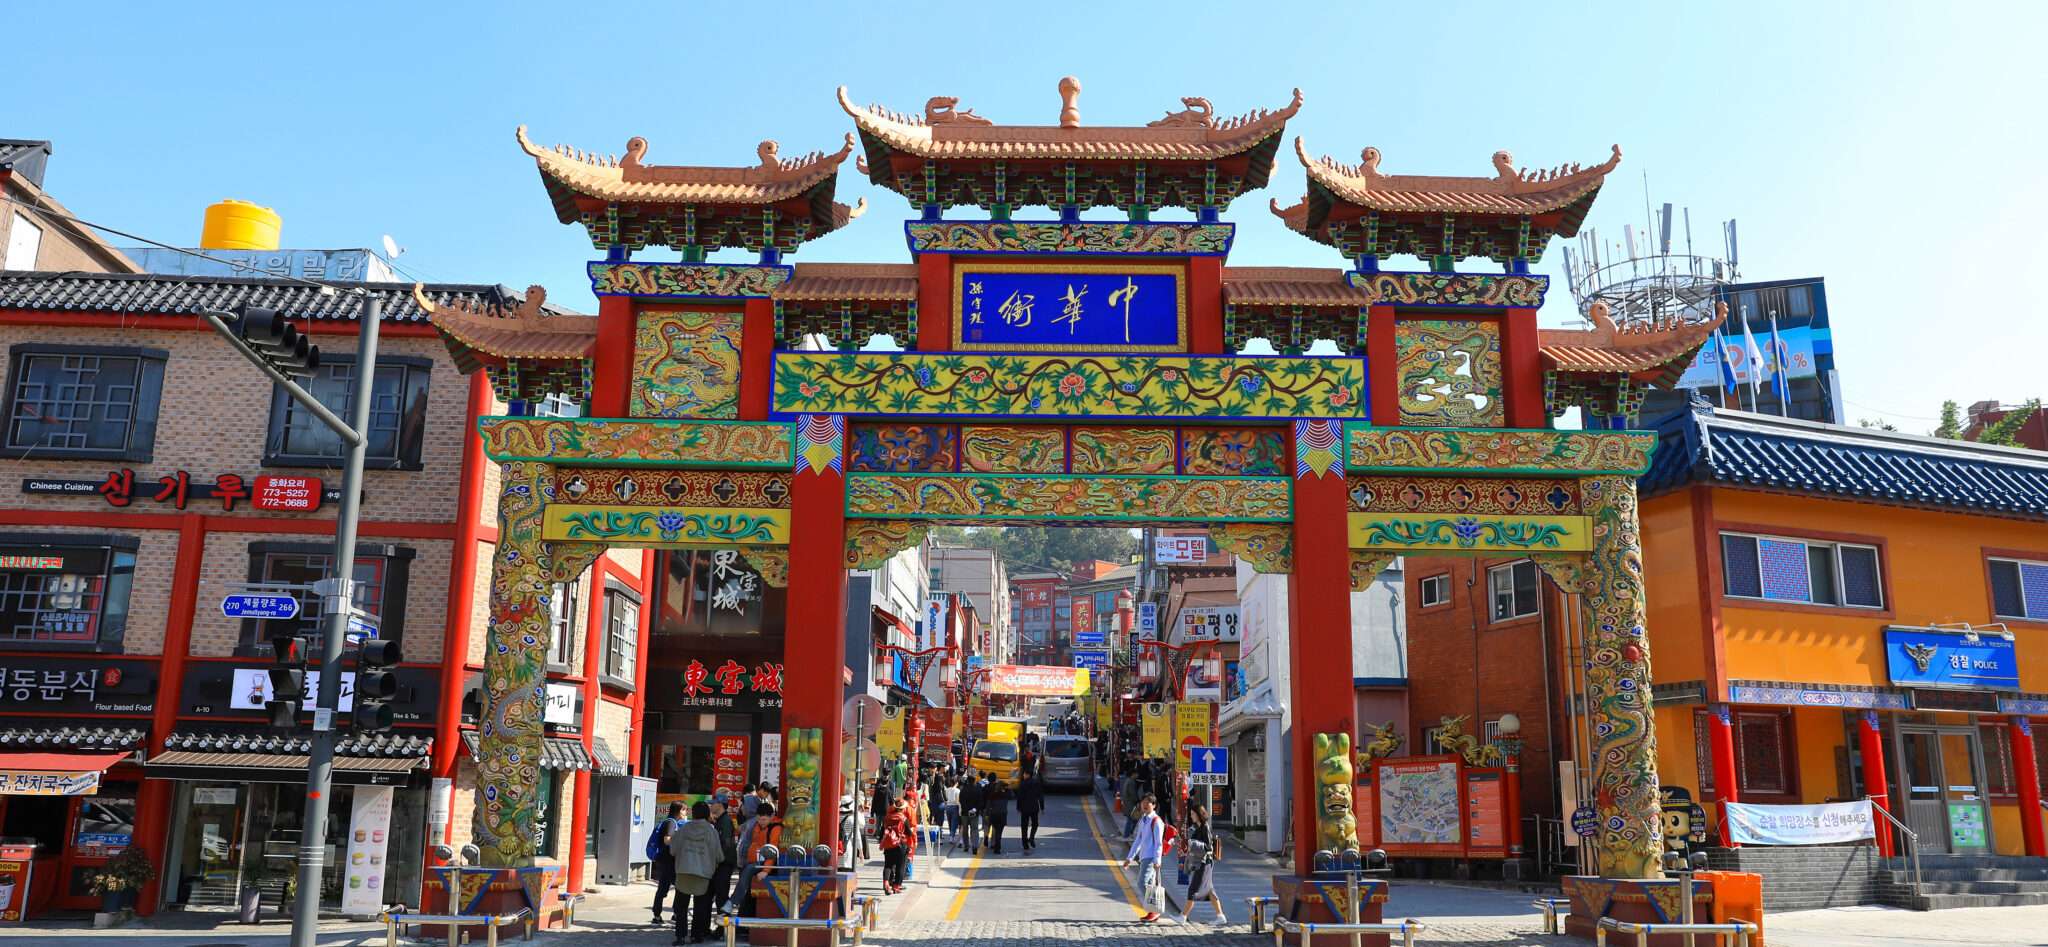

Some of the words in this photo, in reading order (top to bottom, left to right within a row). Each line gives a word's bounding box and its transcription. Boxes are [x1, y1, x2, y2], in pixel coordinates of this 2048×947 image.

[29, 482, 62, 492] Chinese
[64, 483, 94, 493] Cuisine
[269, 478, 305, 488] 중화요리
[99, 470, 248, 512] 신기루
[263, 488, 309, 498] 773-5257
[262, 498, 308, 508] 772-0688
[1180, 540, 1204, 561] 모텔
[243, 598, 277, 609] 제물량로
[1950, 653, 1970, 669] 경찰
[1973, 660, 1999, 670] POLICE
[682, 660, 783, 699] 東宝城
[95, 703, 112, 711] Flour
[114, 704, 134, 712] based
[135, 704, 152, 712] Food
[14, 775, 73, 794] 잔치국수
[1192, 774, 1227, 784] 일방통행
